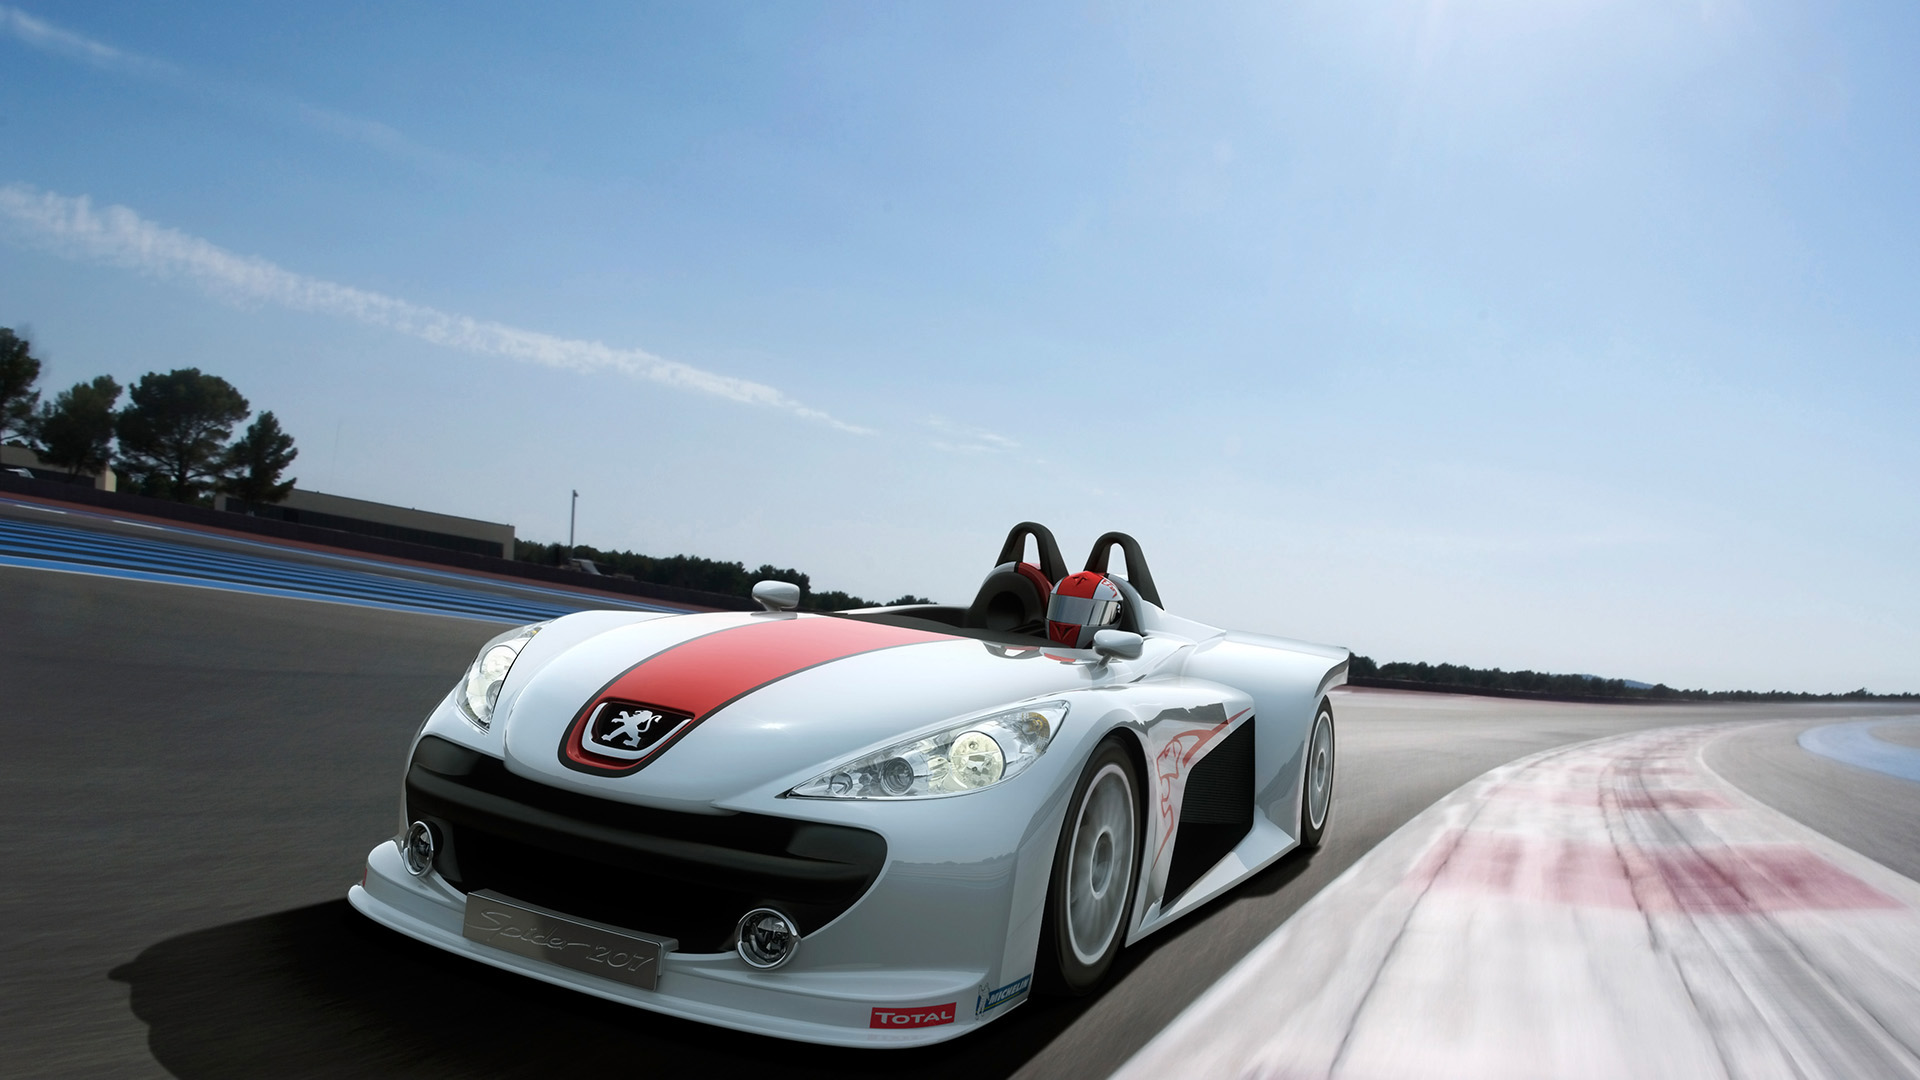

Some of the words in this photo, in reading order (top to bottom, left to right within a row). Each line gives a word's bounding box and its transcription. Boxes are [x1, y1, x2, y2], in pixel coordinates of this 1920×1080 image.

[465, 911, 591, 950] Spider
[585, 945, 654, 972] 207
[988, 977, 1030, 1005] MICHELIN
[874, 1011, 953, 1024] TOTAL
